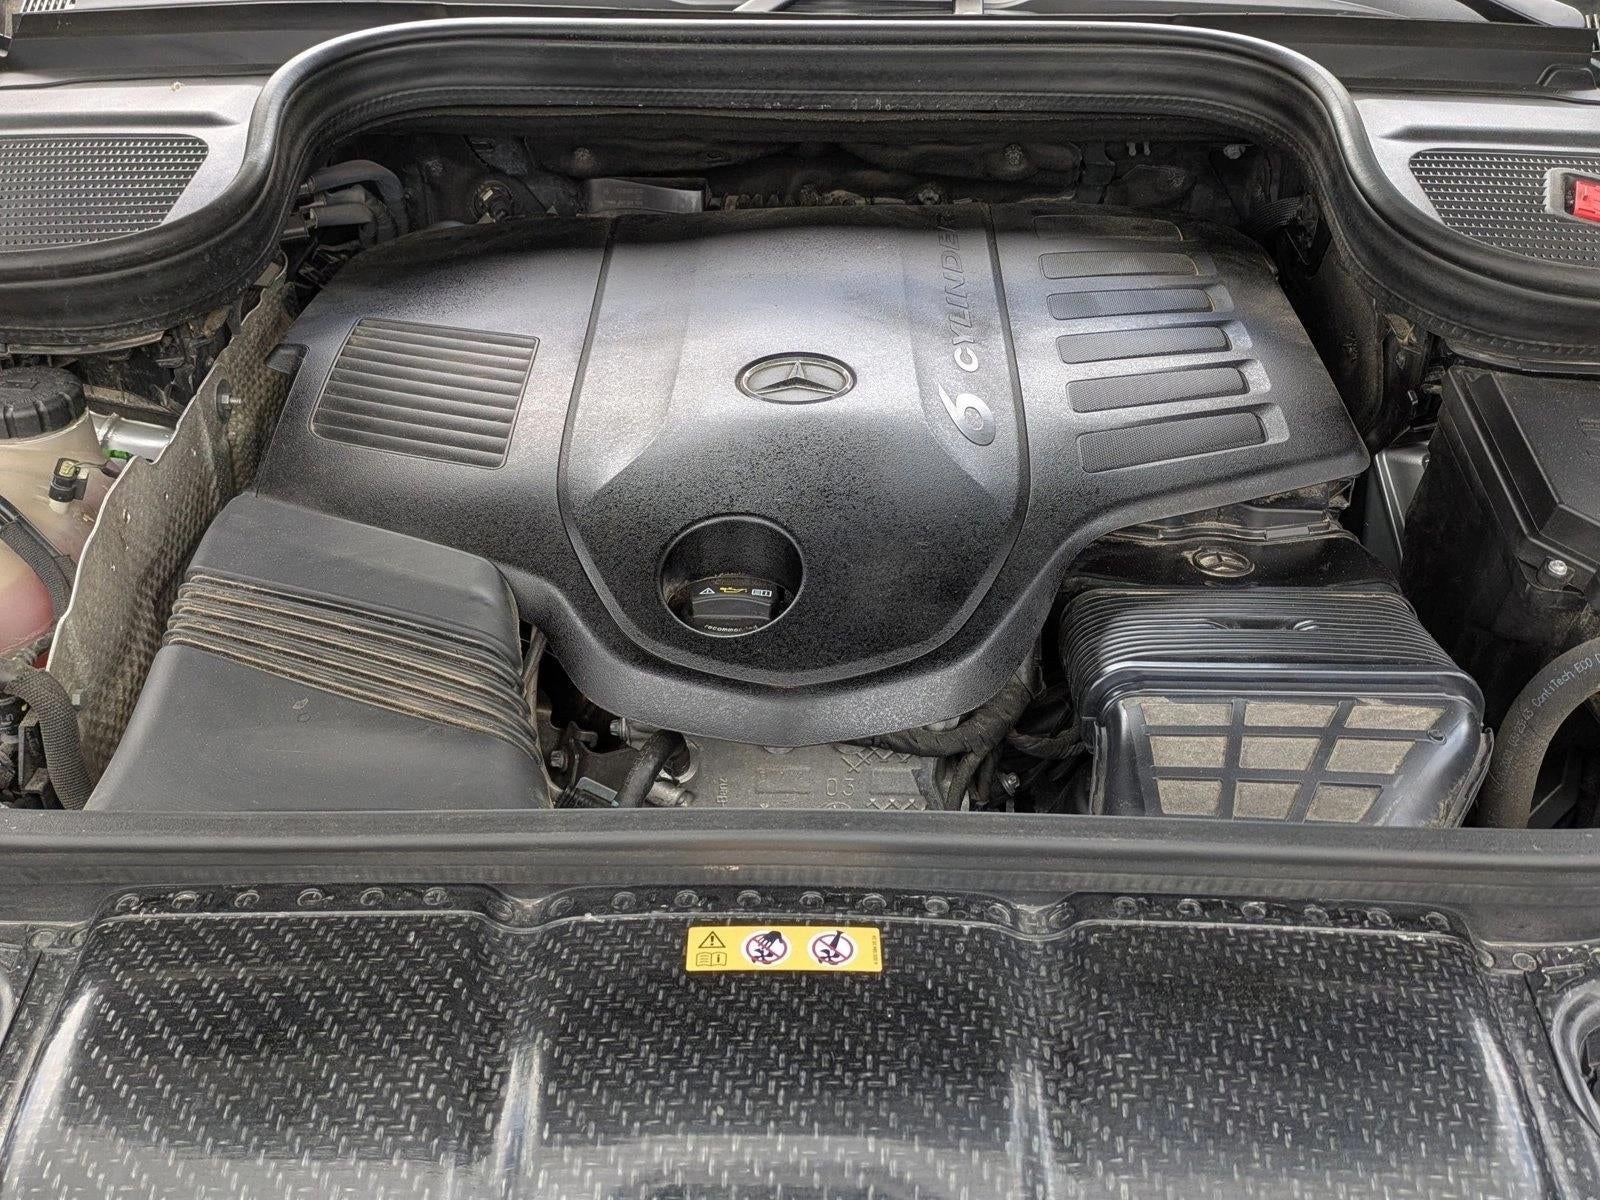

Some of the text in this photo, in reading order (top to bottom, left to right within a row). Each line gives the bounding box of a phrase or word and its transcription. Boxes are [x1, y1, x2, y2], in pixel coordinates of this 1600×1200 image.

[937, 218, 996, 447] 6 CYLINDE
[1531, 670, 1575, 708] ContiTech
[1574, 657, 1593, 674] ECO
